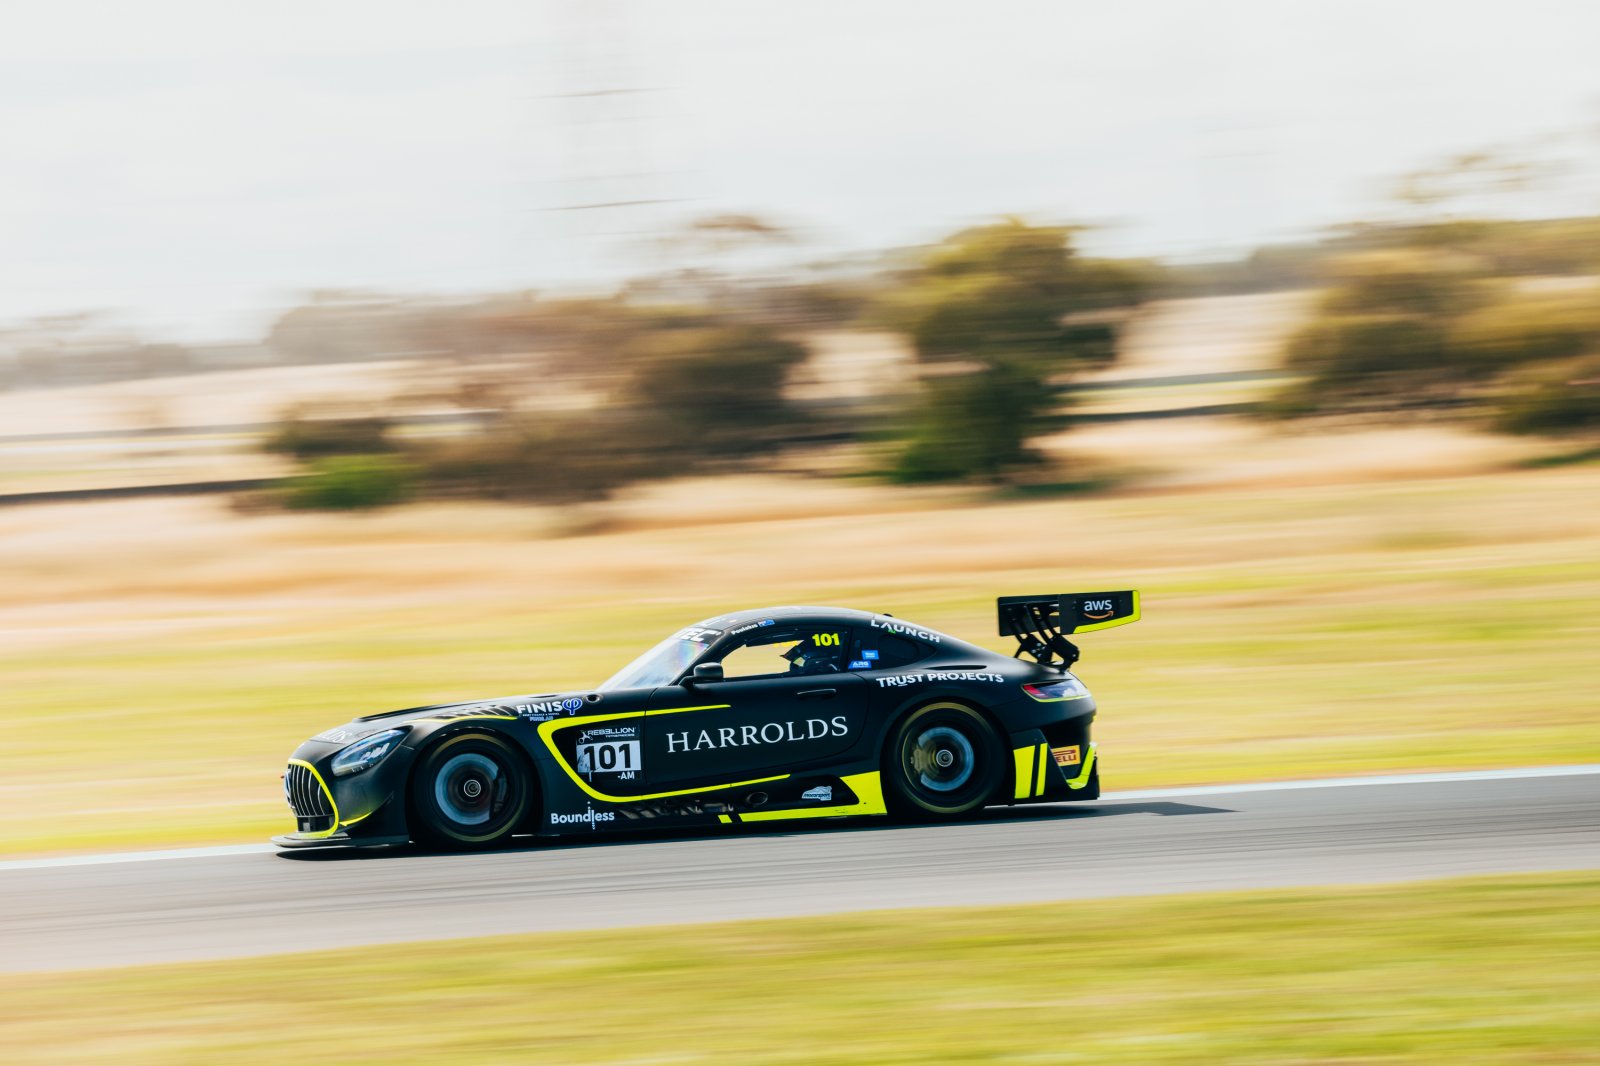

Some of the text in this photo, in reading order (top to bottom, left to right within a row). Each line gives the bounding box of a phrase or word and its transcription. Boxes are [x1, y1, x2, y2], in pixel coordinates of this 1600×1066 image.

[1084, 599, 1113, 612] aws
[870, 619, 940, 643] LAUNCH
[812, 633, 840, 647] 101
[876, 672, 1005, 688] TRUST PROJECTS
[587, 727, 636, 736] REBELLION
[665, 715, 849, 753] HARROLDS
[583, 743, 631, 771] 101
[1054, 752, 1077, 763] ELLI
[550, 805, 615, 829] Boundless
